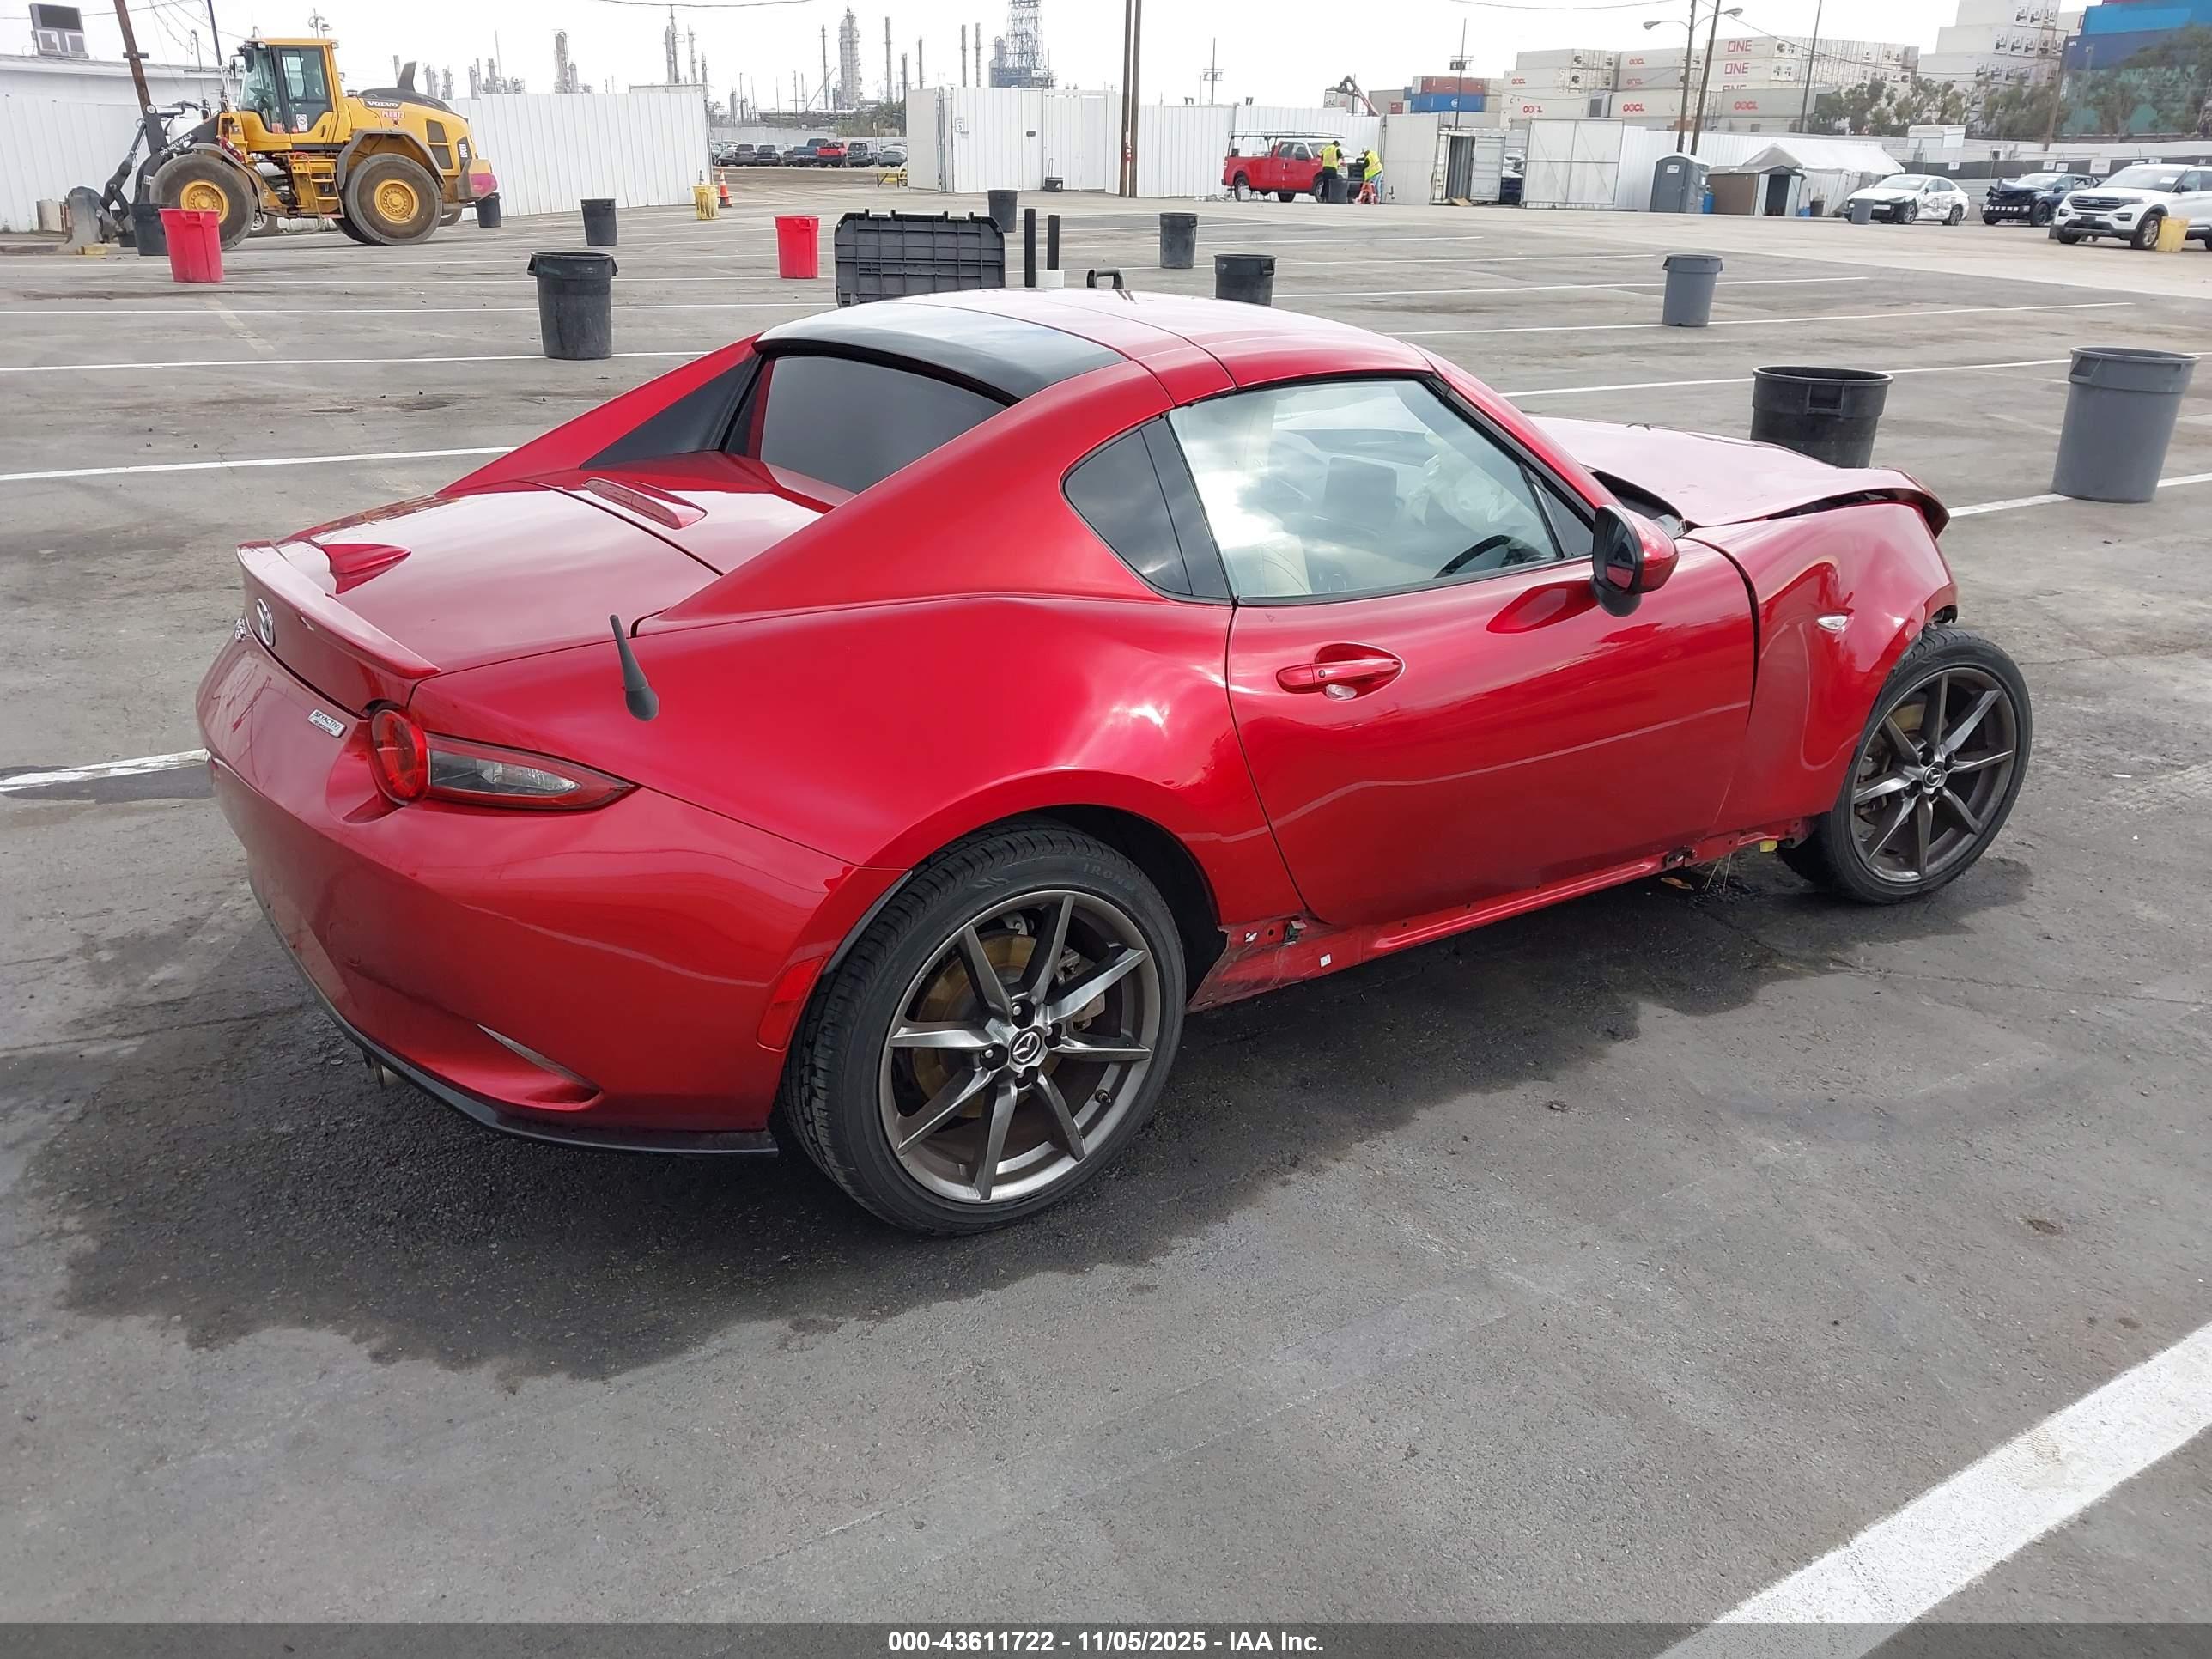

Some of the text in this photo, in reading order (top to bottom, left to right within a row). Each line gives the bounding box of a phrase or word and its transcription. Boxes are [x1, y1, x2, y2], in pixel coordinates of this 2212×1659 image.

[1727, 40, 1753, 52] ONE
[1724, 63, 1750, 75] ONE
[1523, 105, 1543, 113] OOL
[1623, 103, 1644, 112] OOCL
[167, 141, 179, 151] NOT
[178, 132, 193, 144] WALK
[313, 712, 341, 731] SKYACTIV
